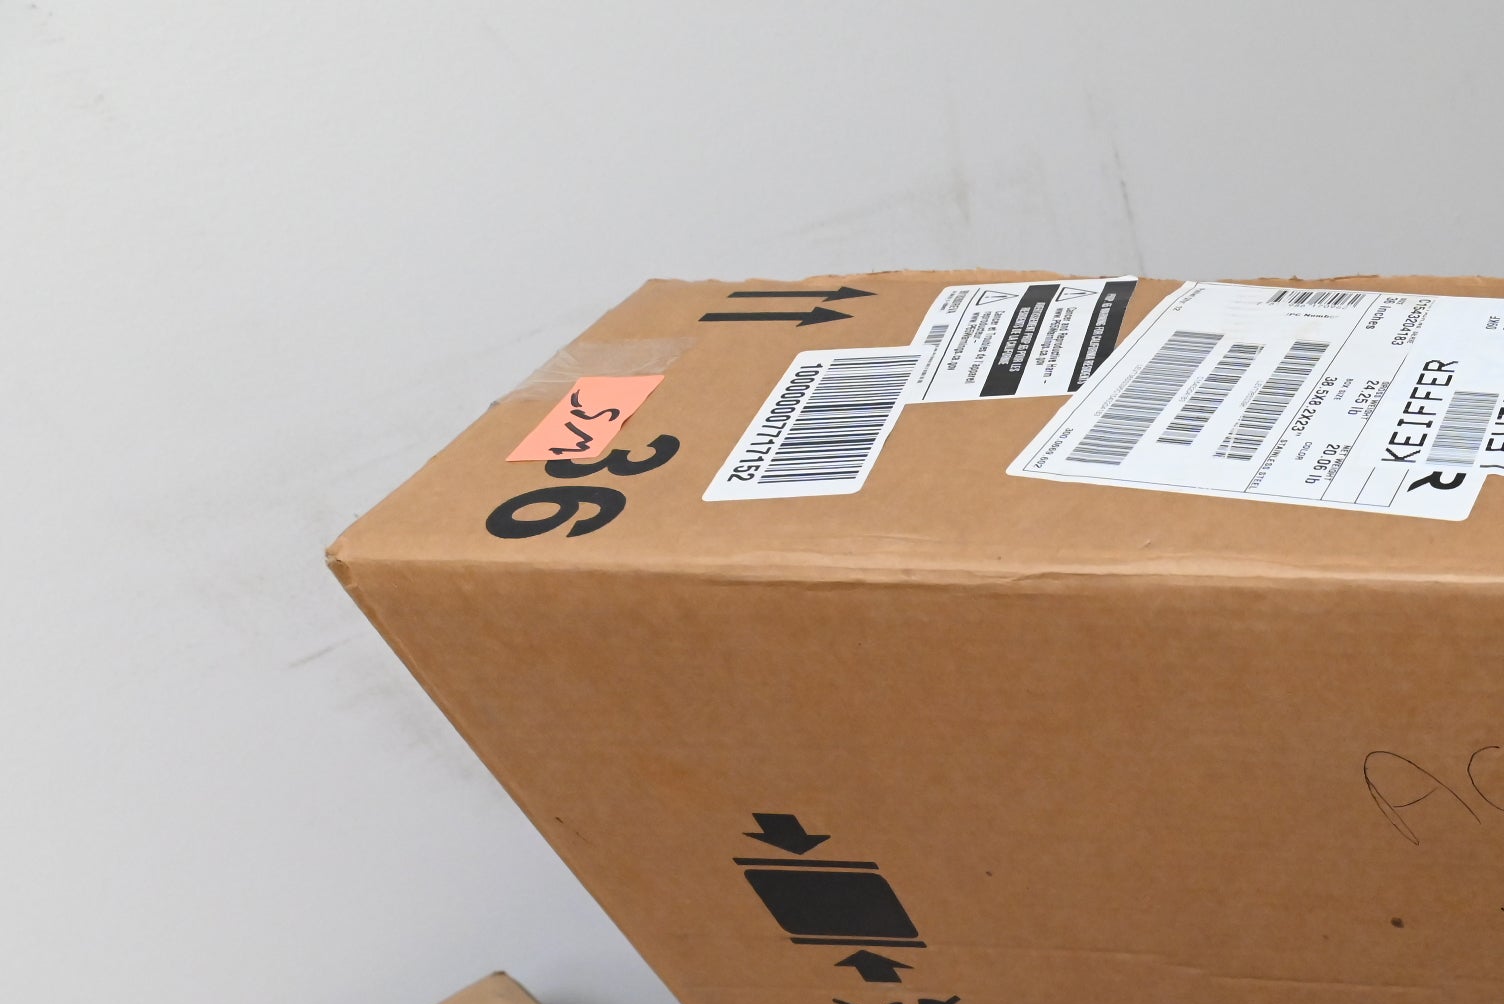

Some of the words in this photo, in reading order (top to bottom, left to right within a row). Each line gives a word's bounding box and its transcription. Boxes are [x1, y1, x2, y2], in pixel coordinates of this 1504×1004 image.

[727, 363, 823, 482] 100000007717152
[1381, 359, 1458, 463] KEIFFER
[485, 433, 681, 540] 36
